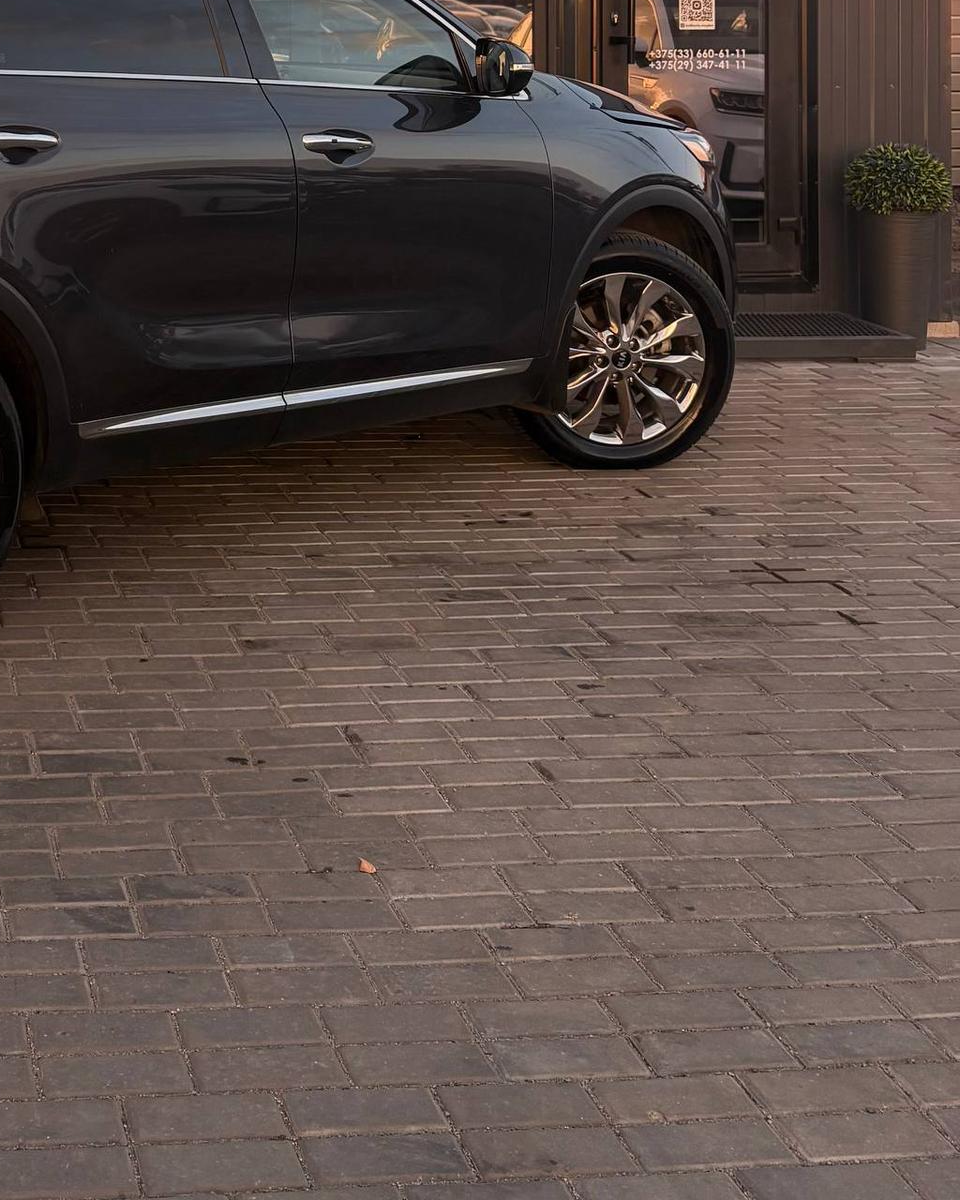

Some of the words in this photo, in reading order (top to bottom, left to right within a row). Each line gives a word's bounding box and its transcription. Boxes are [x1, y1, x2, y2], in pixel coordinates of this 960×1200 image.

[649, 48, 694, 60] +375(33)
[696, 48, 746, 59] 660-61-11
[649, 60, 694, 71] +375(29)
